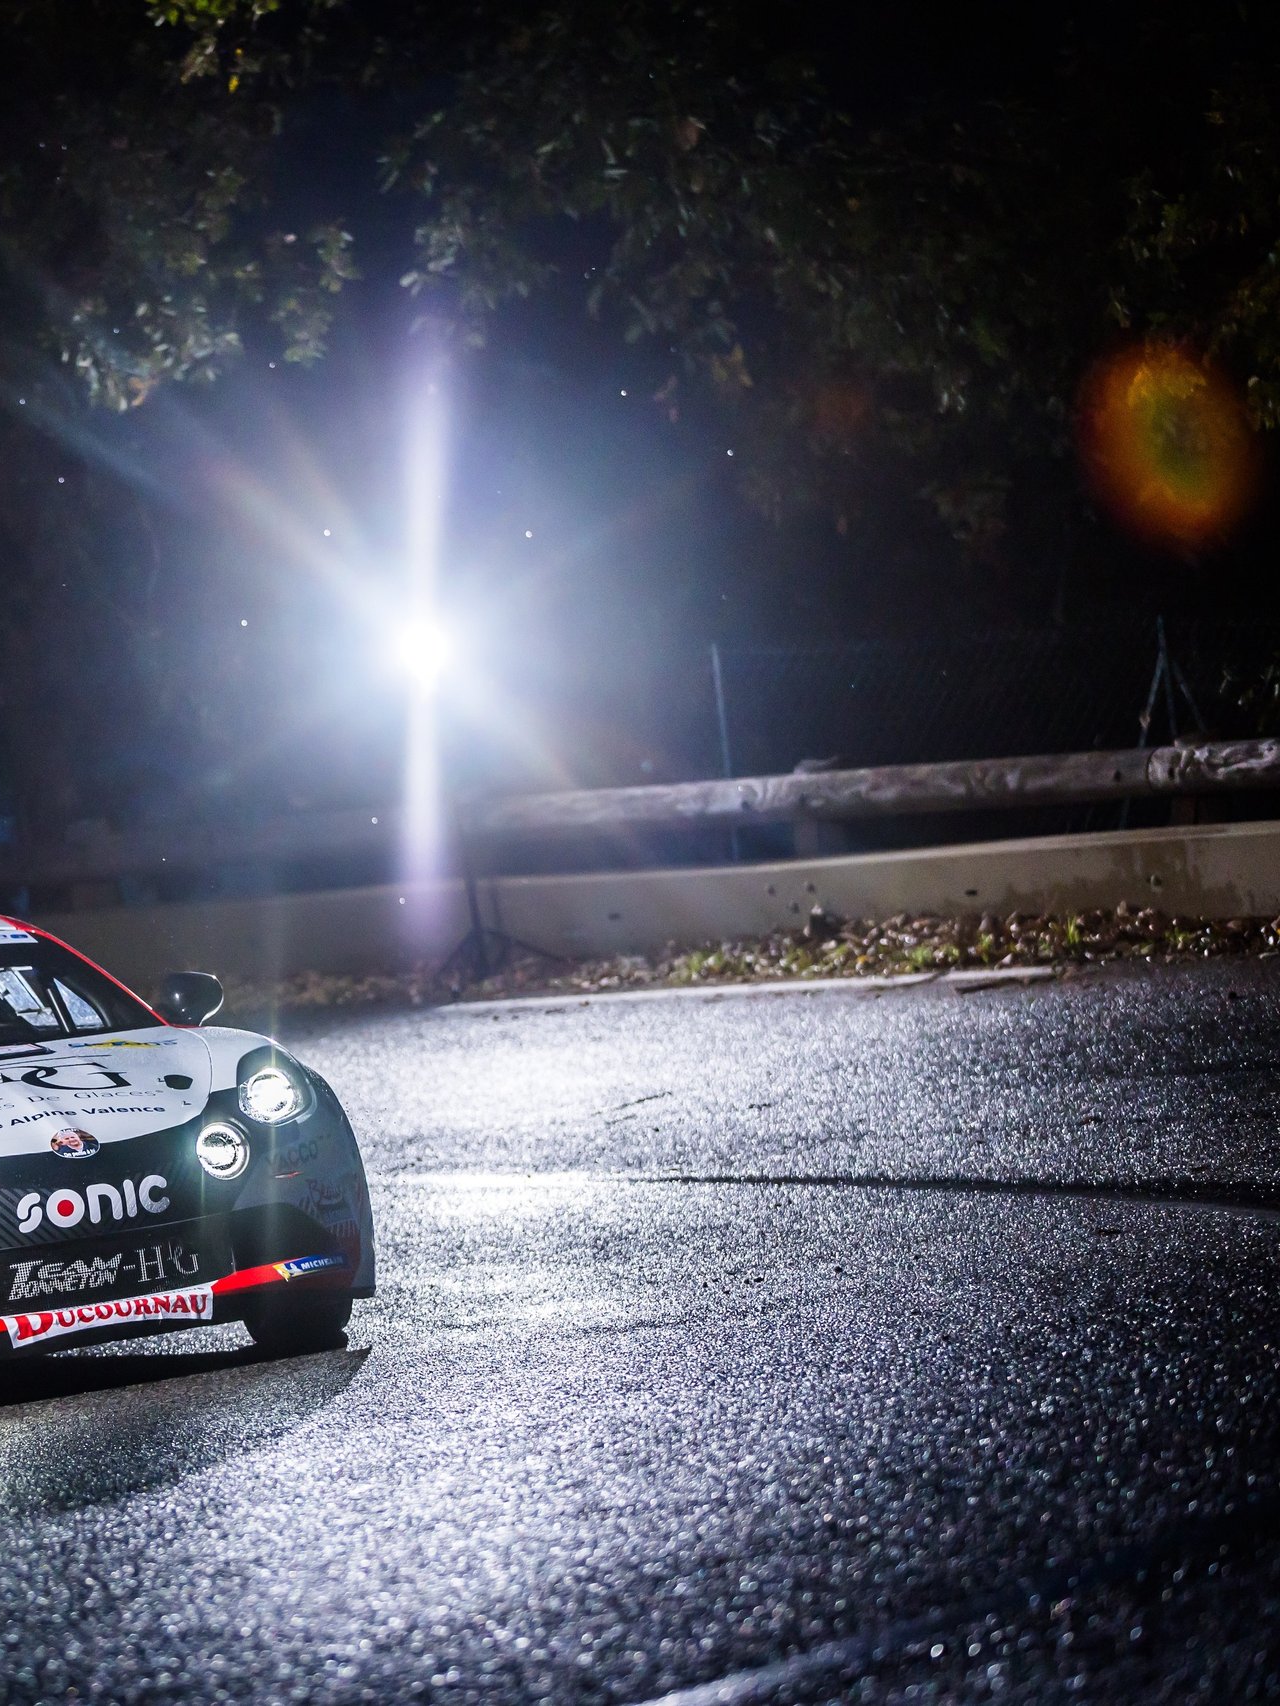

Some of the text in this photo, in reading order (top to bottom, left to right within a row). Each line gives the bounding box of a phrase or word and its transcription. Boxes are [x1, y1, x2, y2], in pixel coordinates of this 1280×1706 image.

[27, 1095, 60, 1103] De
[10, 1109, 77, 1127] Alpine
[82, 1106, 166, 1116] Valence
[300, 1256, 343, 1270] MICHELIN
